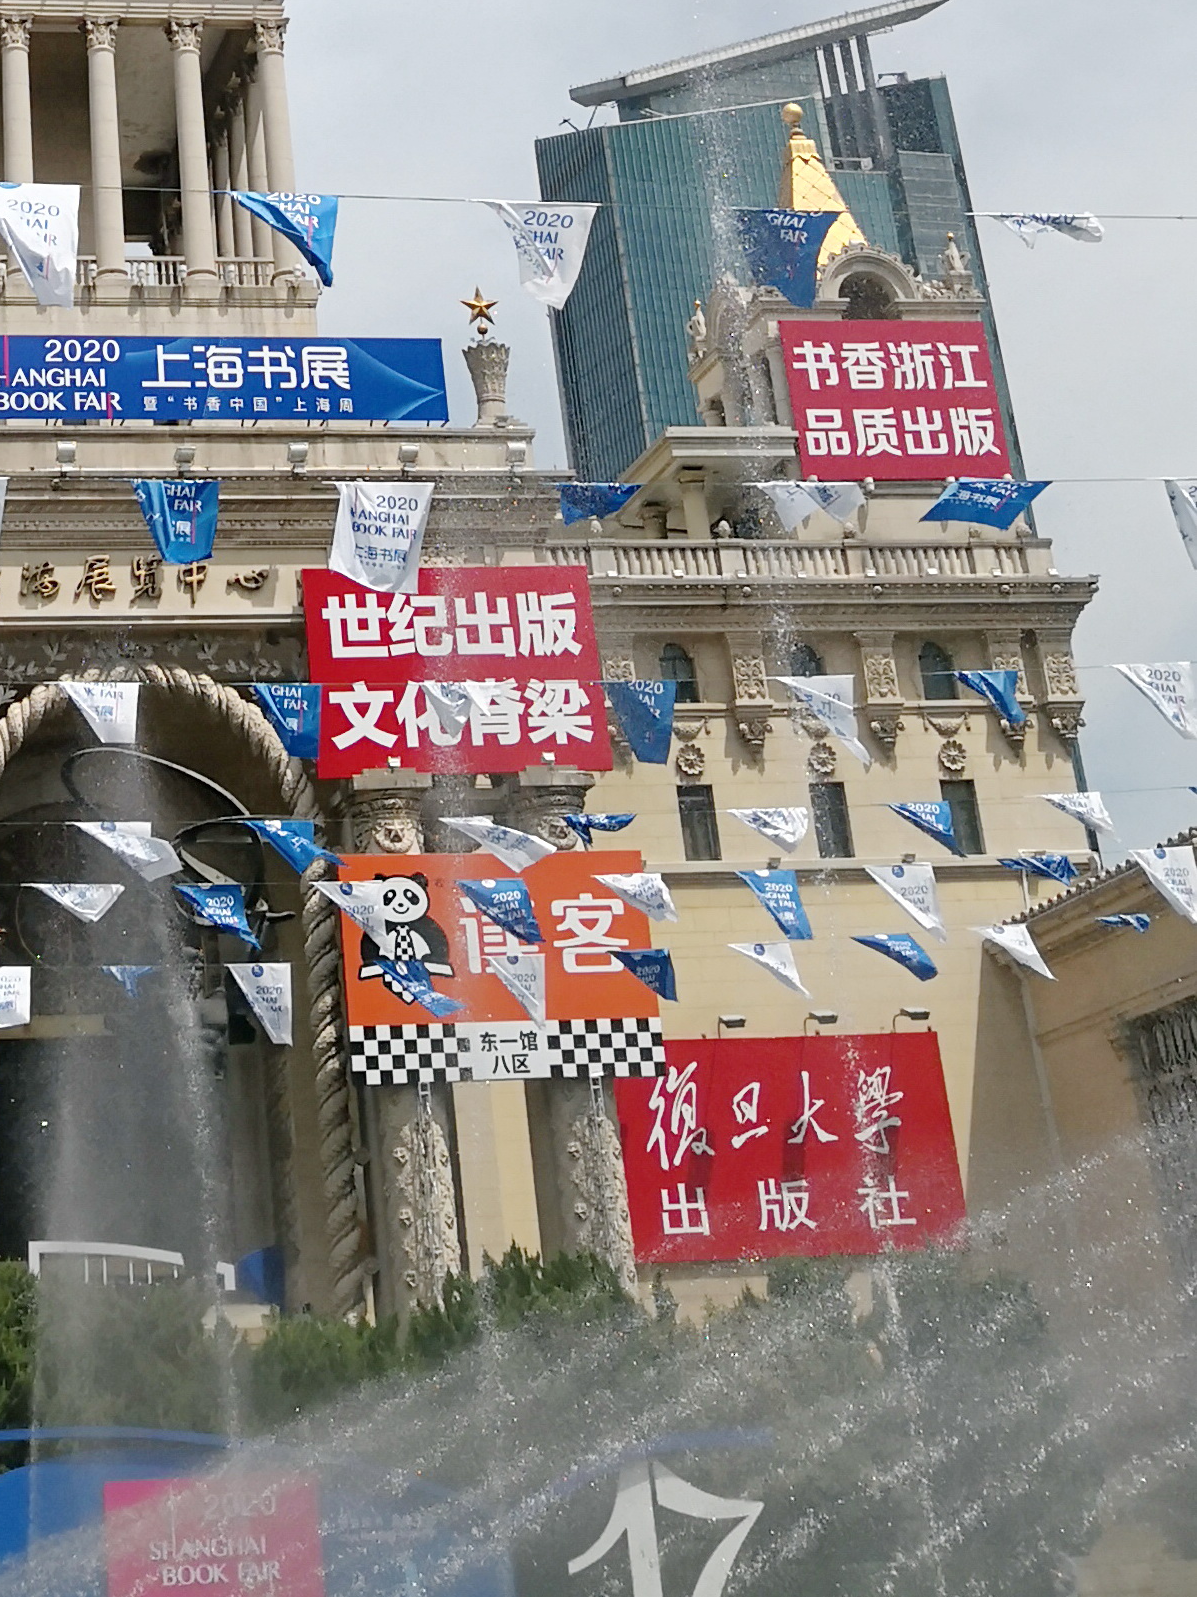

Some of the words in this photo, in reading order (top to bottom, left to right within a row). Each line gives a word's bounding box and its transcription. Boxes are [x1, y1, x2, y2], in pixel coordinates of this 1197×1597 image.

[6, 199, 61, 217] 2020
[523, 210, 574, 229] 2020
[766, 212, 807, 229] GHAI
[780, 229, 809, 245] FAIR
[44, 339, 121, 364] 2020
[141, 344, 352, 391] 上海书展
[792, 340, 989, 391] 书香浙江
[74, 391, 123, 413] FAIR
[805, 406, 1002, 457] 品质出版
[174, 499, 202, 513] FAIR
[376, 495, 419, 511] 2020
[392, 526, 418, 540] FAIR
[321, 590, 583, 659] 世纪出版
[1145, 668, 1182, 683] 2020
[627, 680, 664, 695] 2020
[283, 698, 308, 712] FAIR
[907, 803, 940, 815] 2020
[1163, 867, 1190, 877] 2020
[764, 882, 794, 893] 2020
[900, 885, 929, 897] 2020
[205, 896, 236, 909] 2020
[491, 890, 522, 904] 2020
[635, 964, 661, 976] 2020
[255, 984, 283, 996] 2020
[479, 1031, 544, 1052] 东一馆
[492, 1054, 531, 1074] 八区
[661, 1174, 917, 1236] 出版社
[162, 1562, 229, 1587] BOOK
